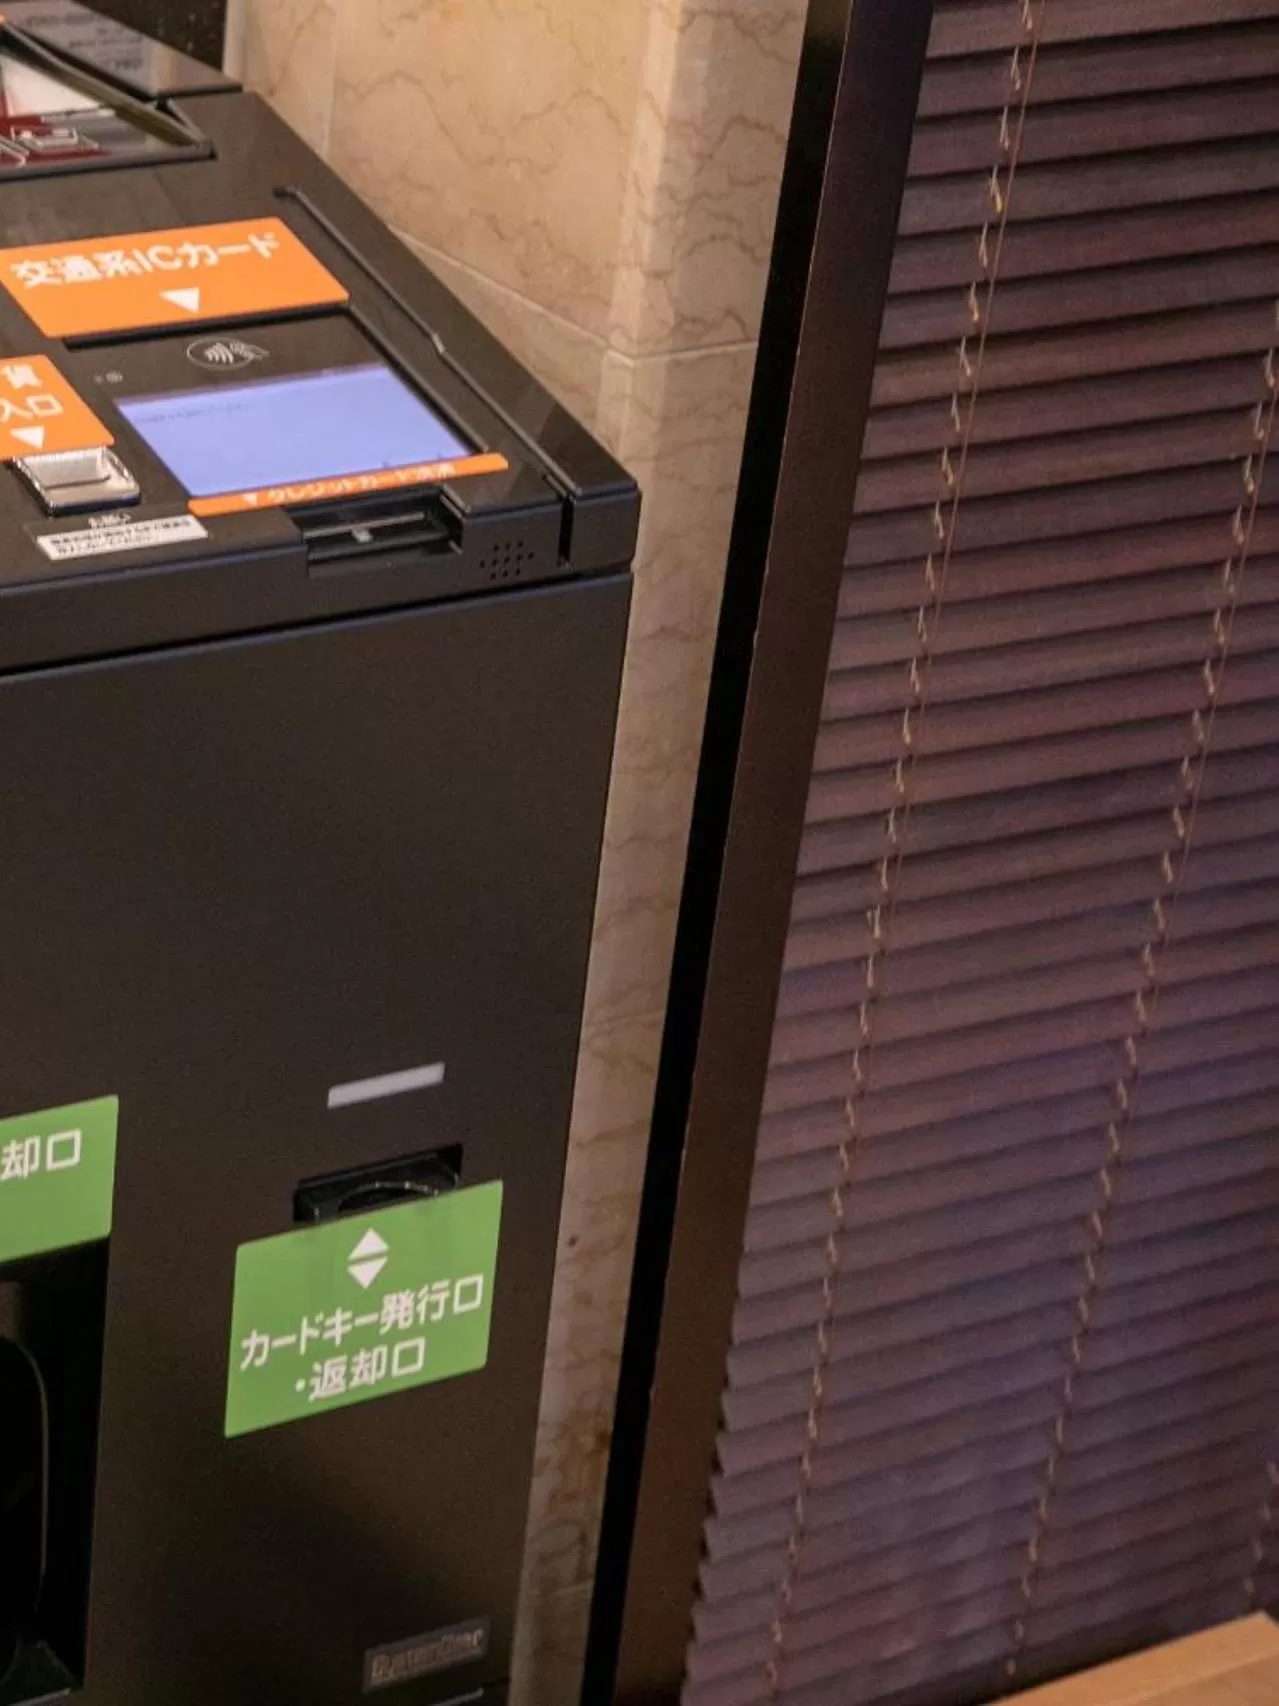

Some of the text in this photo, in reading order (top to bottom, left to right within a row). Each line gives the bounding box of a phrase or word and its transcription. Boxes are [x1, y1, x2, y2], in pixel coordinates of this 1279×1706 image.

[10, 231, 283, 288] 交通系ICカード
[240, 1273, 485, 1371] カードキー発行口
